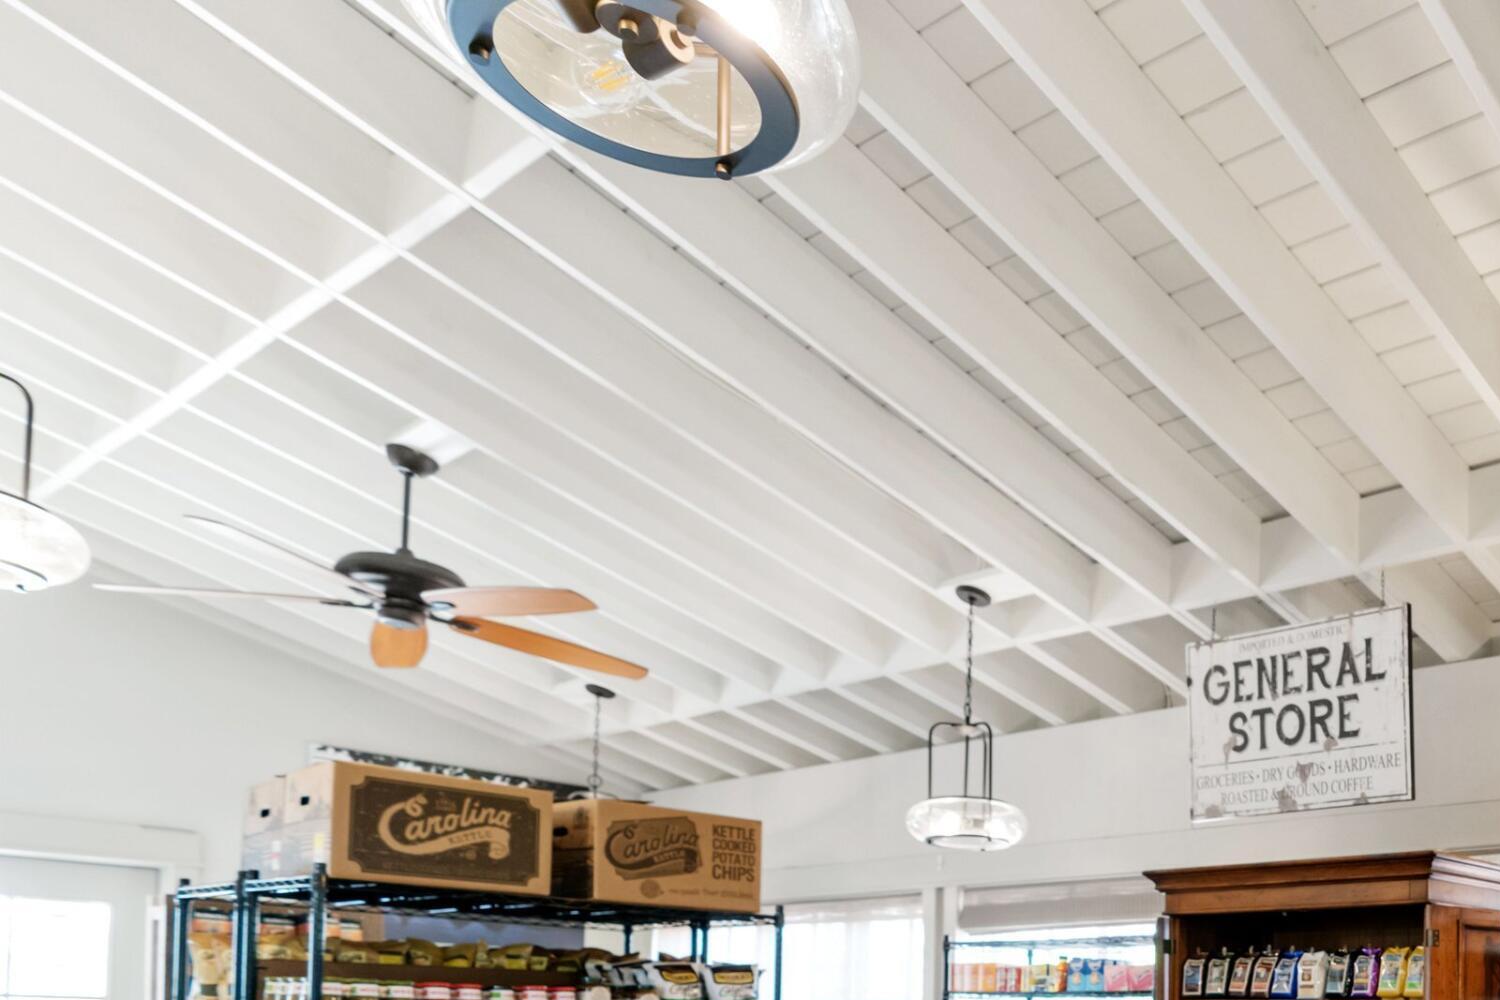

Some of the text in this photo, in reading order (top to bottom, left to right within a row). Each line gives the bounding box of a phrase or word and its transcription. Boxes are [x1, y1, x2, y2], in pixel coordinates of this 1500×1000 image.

[1203, 637, 1387, 706] GENERAL
[1229, 694, 1361, 753] STORE
[1196, 771, 1254, 790] GROCERIES
[1262, 765, 1284, 782] DRY
[1334, 752, 1401, 774] HARDWARE
[1220, 788, 1270, 806] ROASTED
[1331, 775, 1374, 793] COFFEE
[378, 793, 512, 855] Carolina
[711, 824, 756, 841] KETTLE
[604, 823, 700, 871] Carolina
[711, 838, 756, 854] COOKED
[711, 851, 756, 867] POTATO
[711, 865, 756, 882] CHIPS
